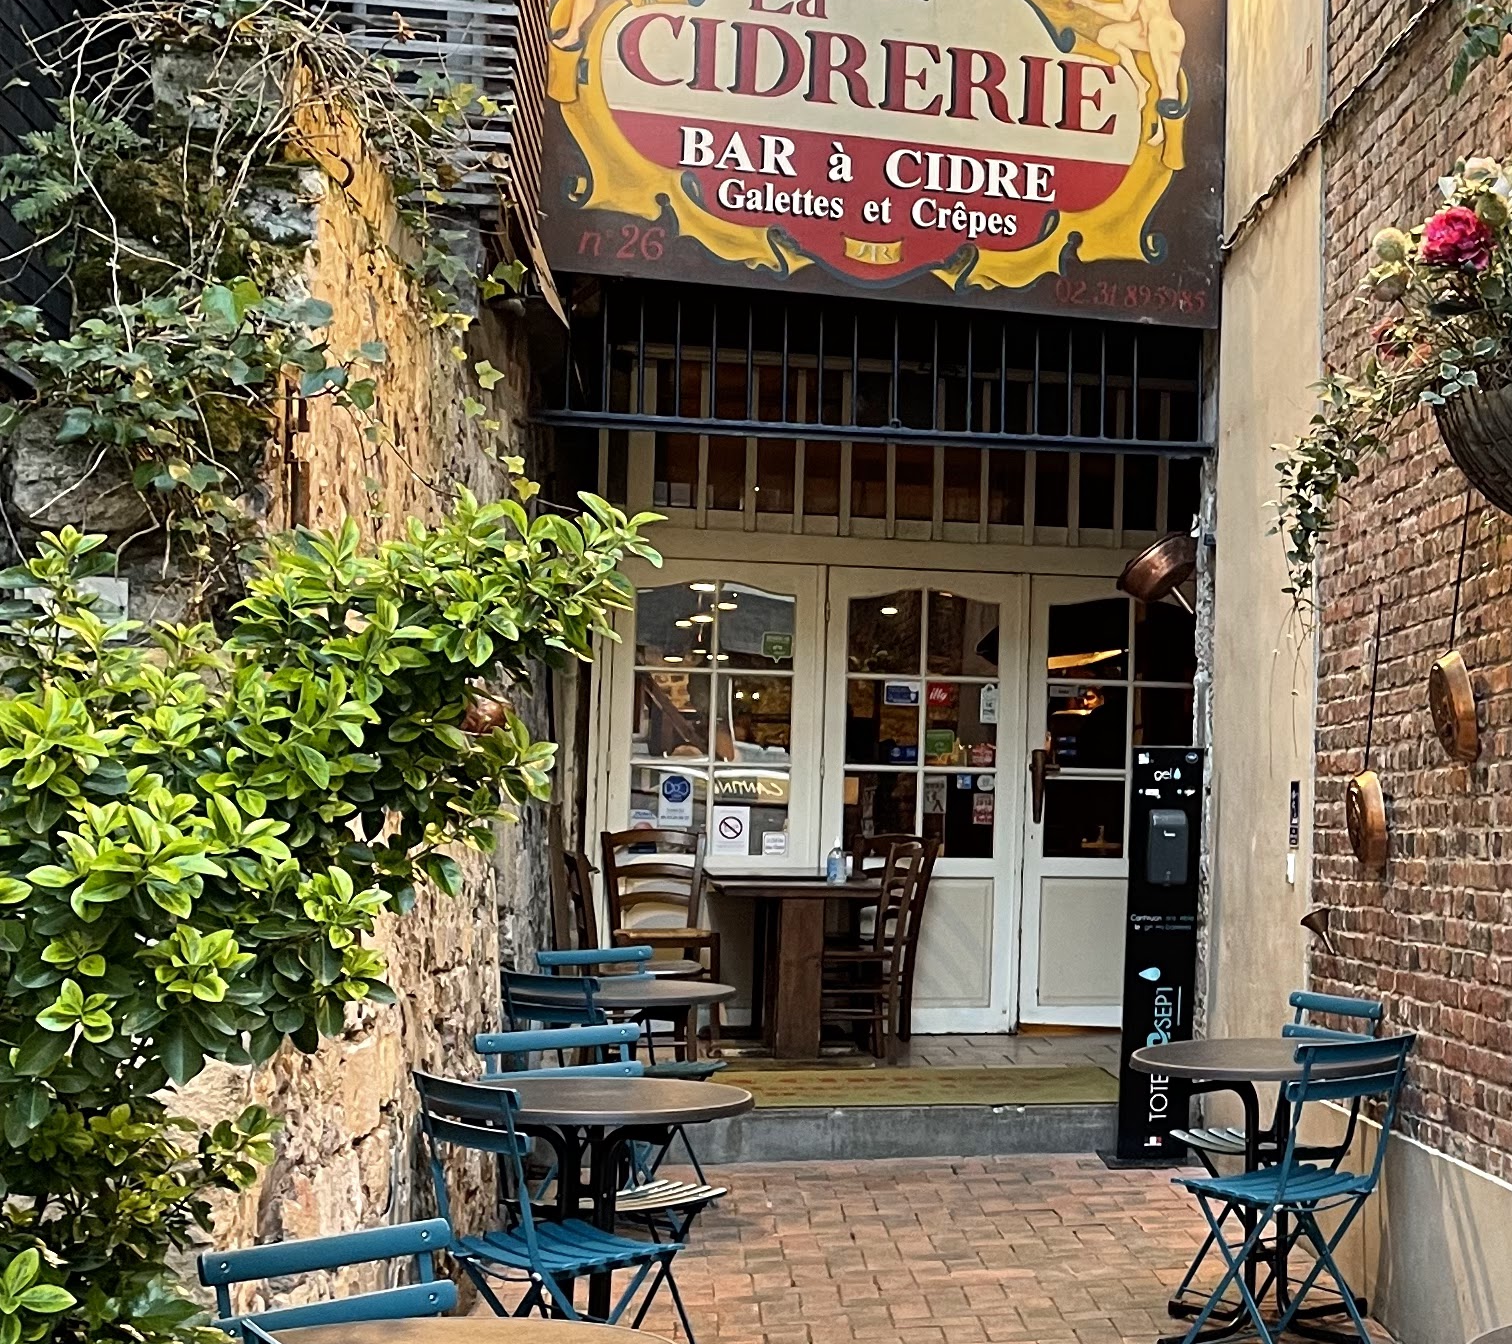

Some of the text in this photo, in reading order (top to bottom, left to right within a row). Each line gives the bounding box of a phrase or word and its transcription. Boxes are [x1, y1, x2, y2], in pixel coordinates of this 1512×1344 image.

[617, 12, 1119, 136] CIDRERIE
[679, 126, 1057, 205] BAR à CIDRE
[717, 177, 1018, 239] Galettes et Crêpes
[616, 223, 666, 261] 26
[929, 688, 948, 702] illy
